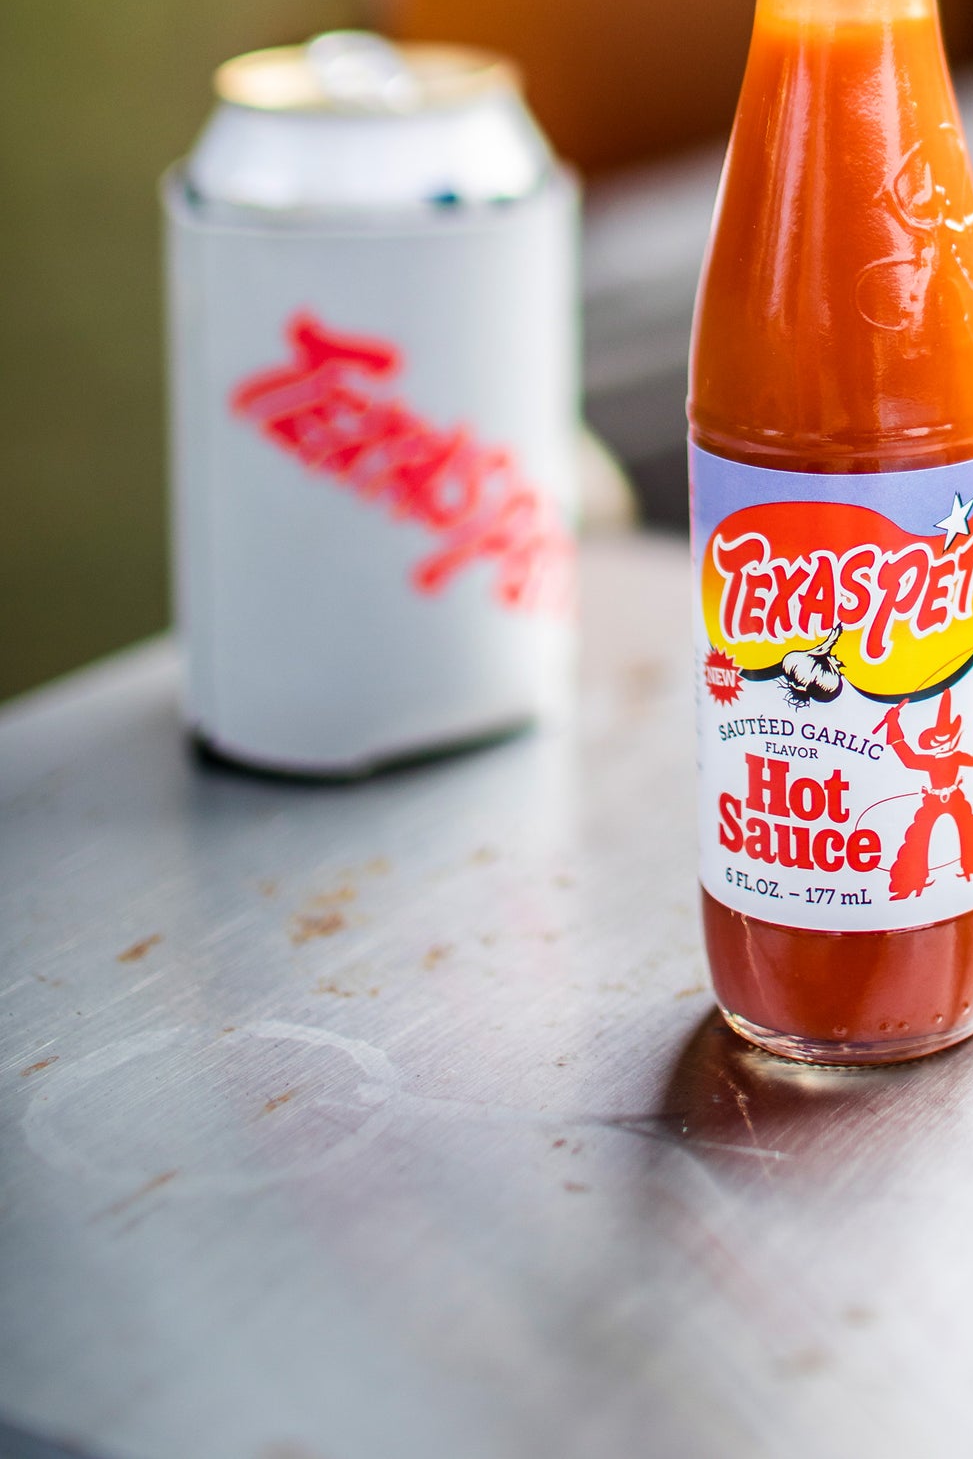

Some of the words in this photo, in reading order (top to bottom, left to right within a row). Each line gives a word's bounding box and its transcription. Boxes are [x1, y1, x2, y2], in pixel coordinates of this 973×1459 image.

[713, 533, 878, 643] TEXAS
[706, 666, 736, 688] NEW
[718, 715, 794, 741] SAUTÉED
[801, 724, 884, 761] GARLIC
[765, 742, 819, 759] FLAVOR
[745, 753, 850, 824] Hot
[718, 792, 882, 873] Sauce
[725, 867, 734, 883] 6
[805, 887, 836, 905] 177
[840, 889, 872, 905] mL
